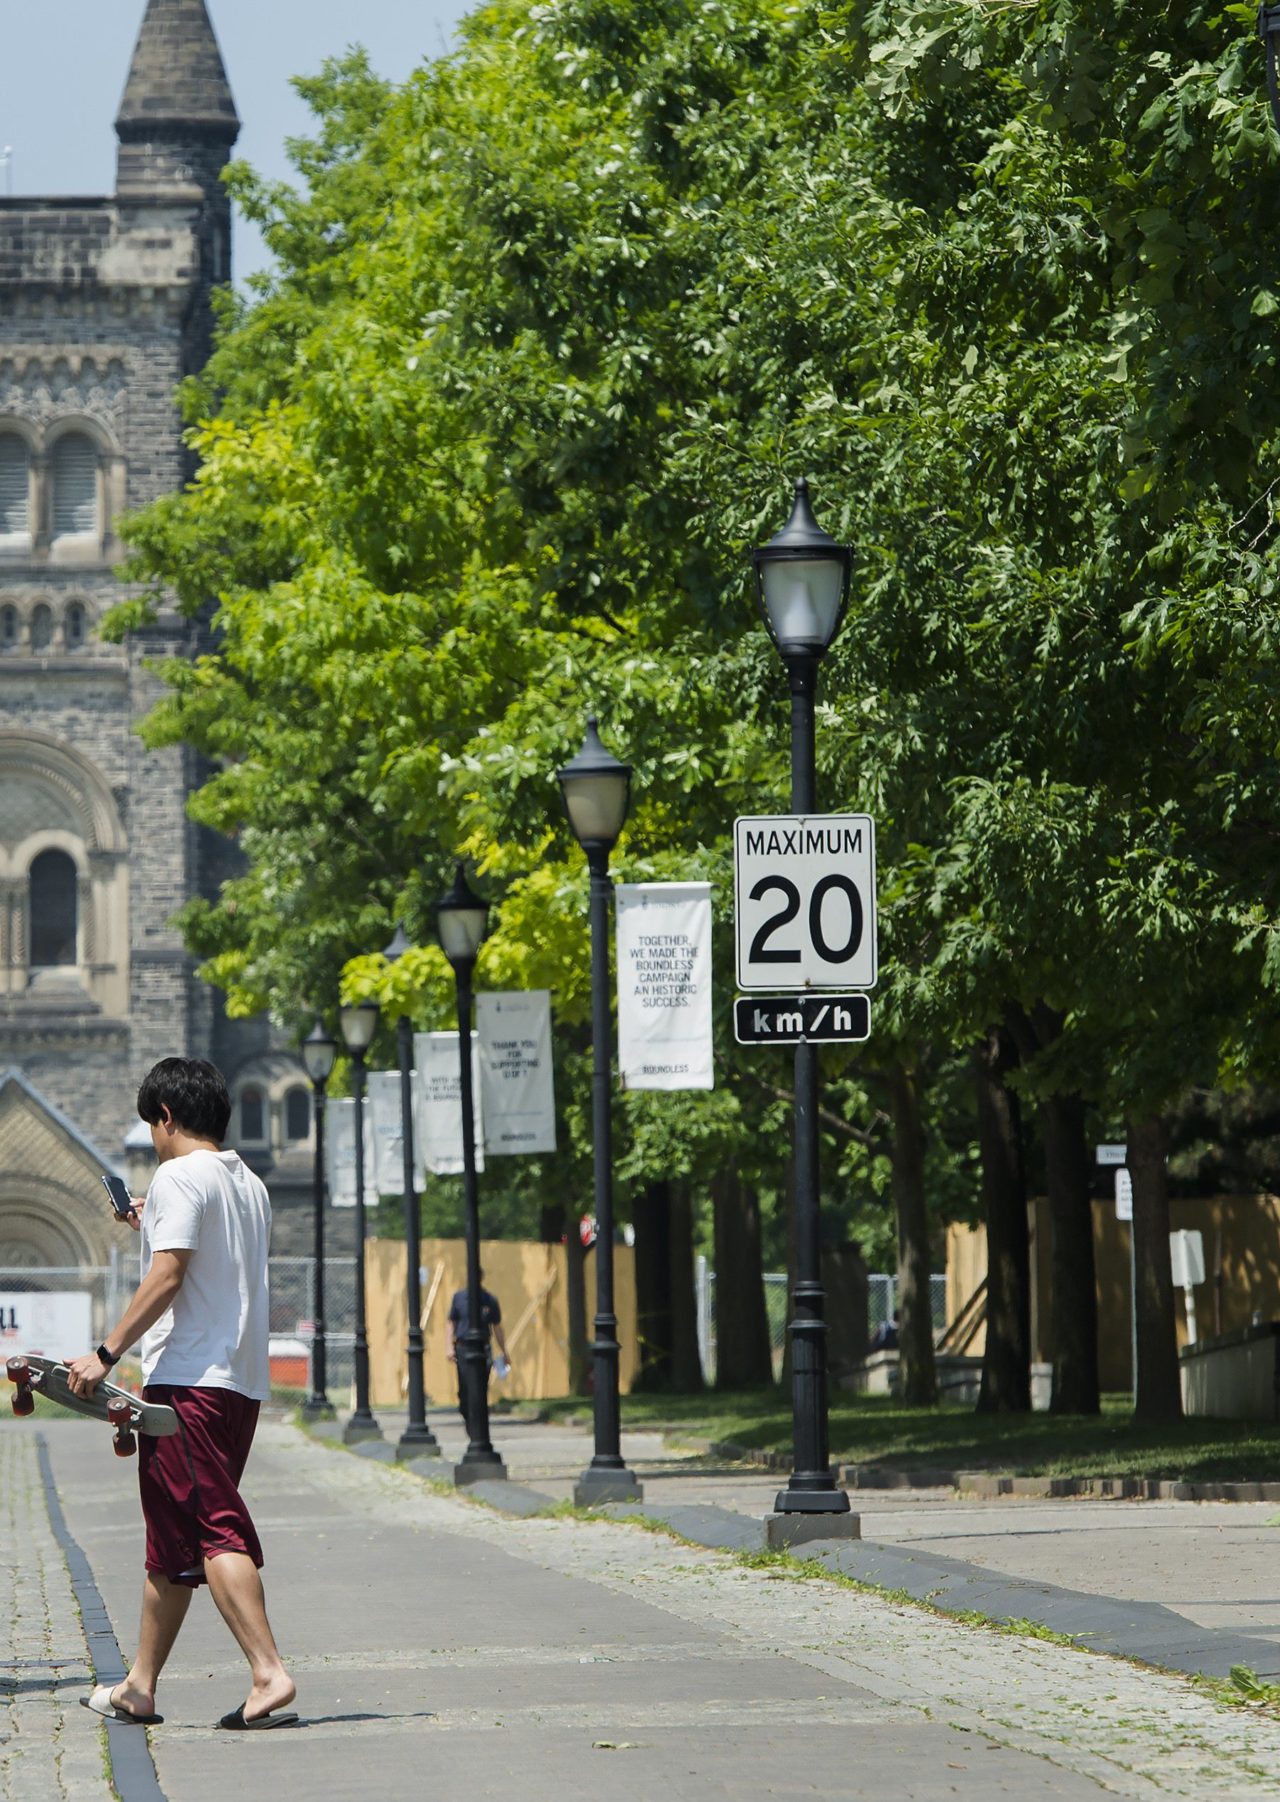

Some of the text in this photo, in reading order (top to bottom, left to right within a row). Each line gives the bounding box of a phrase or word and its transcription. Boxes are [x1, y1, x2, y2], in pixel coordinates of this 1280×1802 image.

[746, 828, 862, 856] MAXIMUM
[748, 873, 863, 964] 20
[630, 947, 699, 959] WE MADE THE
[636, 959, 694, 971] BOUNDLESS
[639, 972, 691, 983] CAMPAIGN
[634, 984, 697, 995] AN HISTORIC
[753, 1004, 852, 1034] km/h
[642, 1064, 689, 1074] BOUNDLESS
